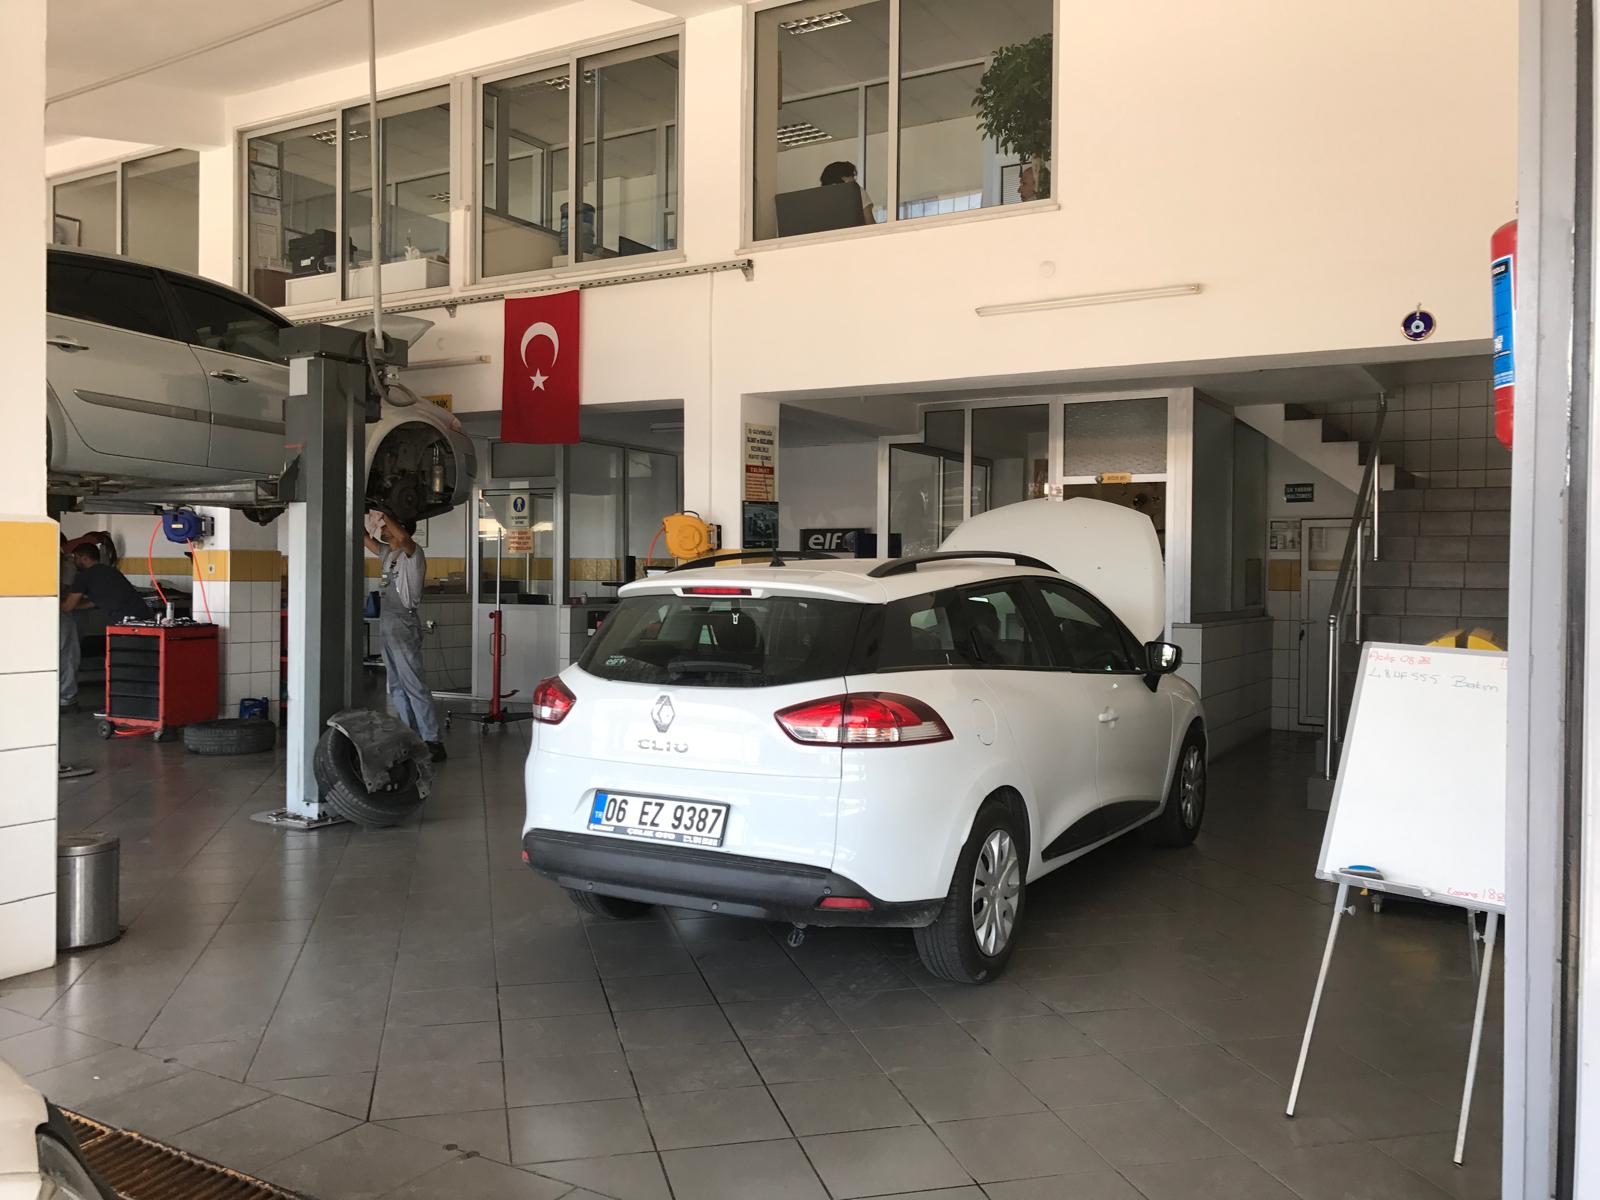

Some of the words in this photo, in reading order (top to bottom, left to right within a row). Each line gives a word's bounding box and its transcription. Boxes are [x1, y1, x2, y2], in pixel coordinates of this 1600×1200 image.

[808, 532, 843, 550] elf
[637, 738, 689, 754] CLIO
[605, 797, 629, 823] 06
[638, 800, 665, 828] EZ
[671, 804, 723, 834] 9387
